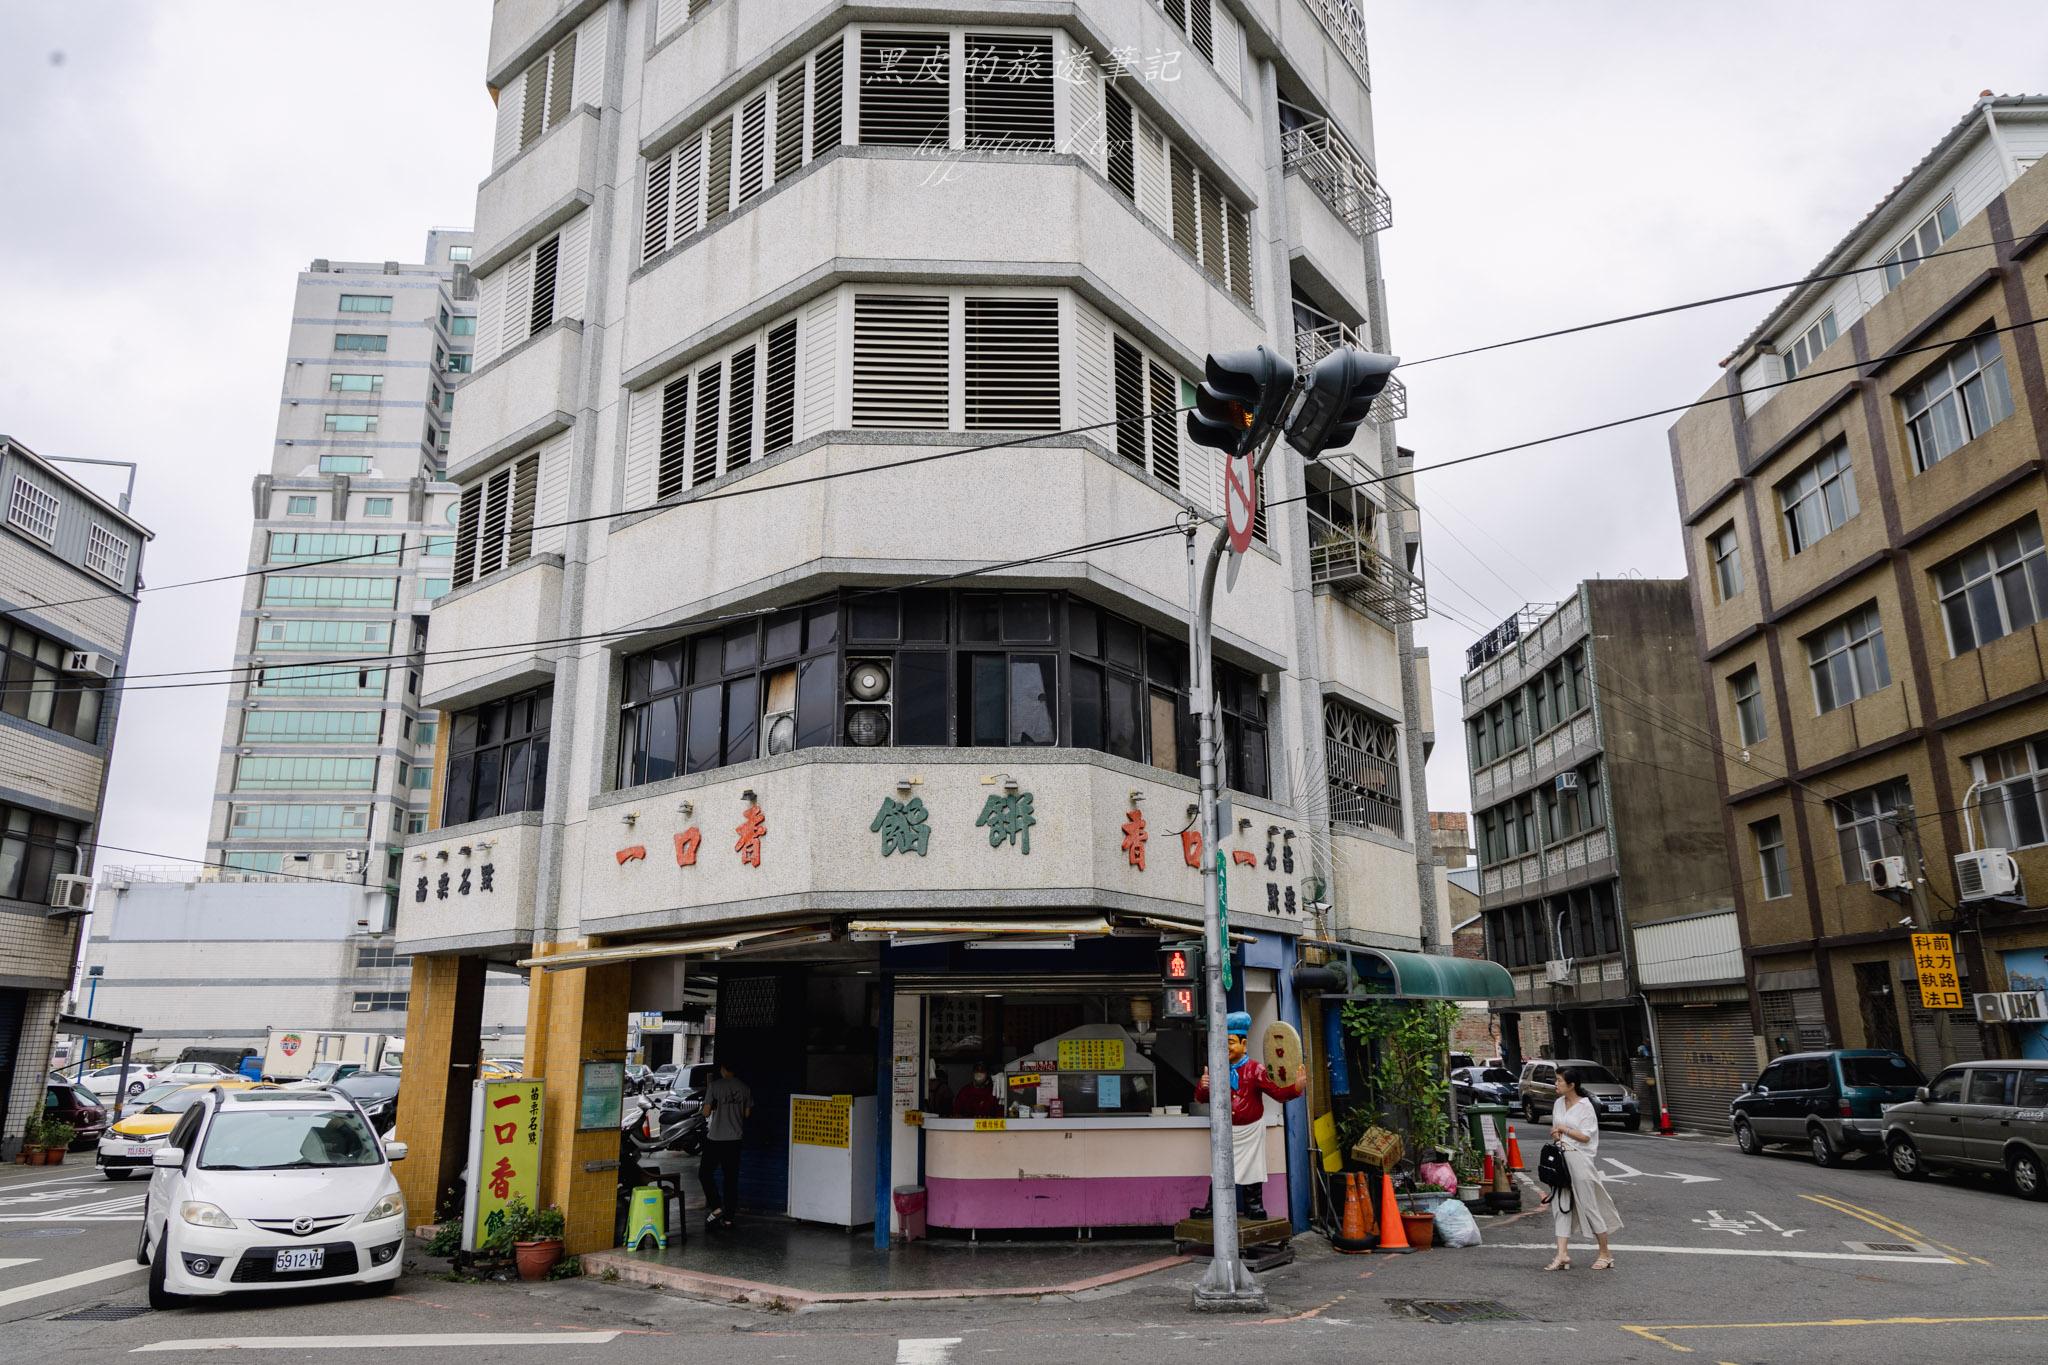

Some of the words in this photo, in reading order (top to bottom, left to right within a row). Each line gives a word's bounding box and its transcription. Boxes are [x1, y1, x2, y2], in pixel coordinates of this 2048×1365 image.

[616, 804, 768, 869] 一口香
[1178, 990, 1191, 1012] 4
[1914, 936, 1942, 1006] 科技執法
[1932, 936, 1959, 1005] 前方路口
